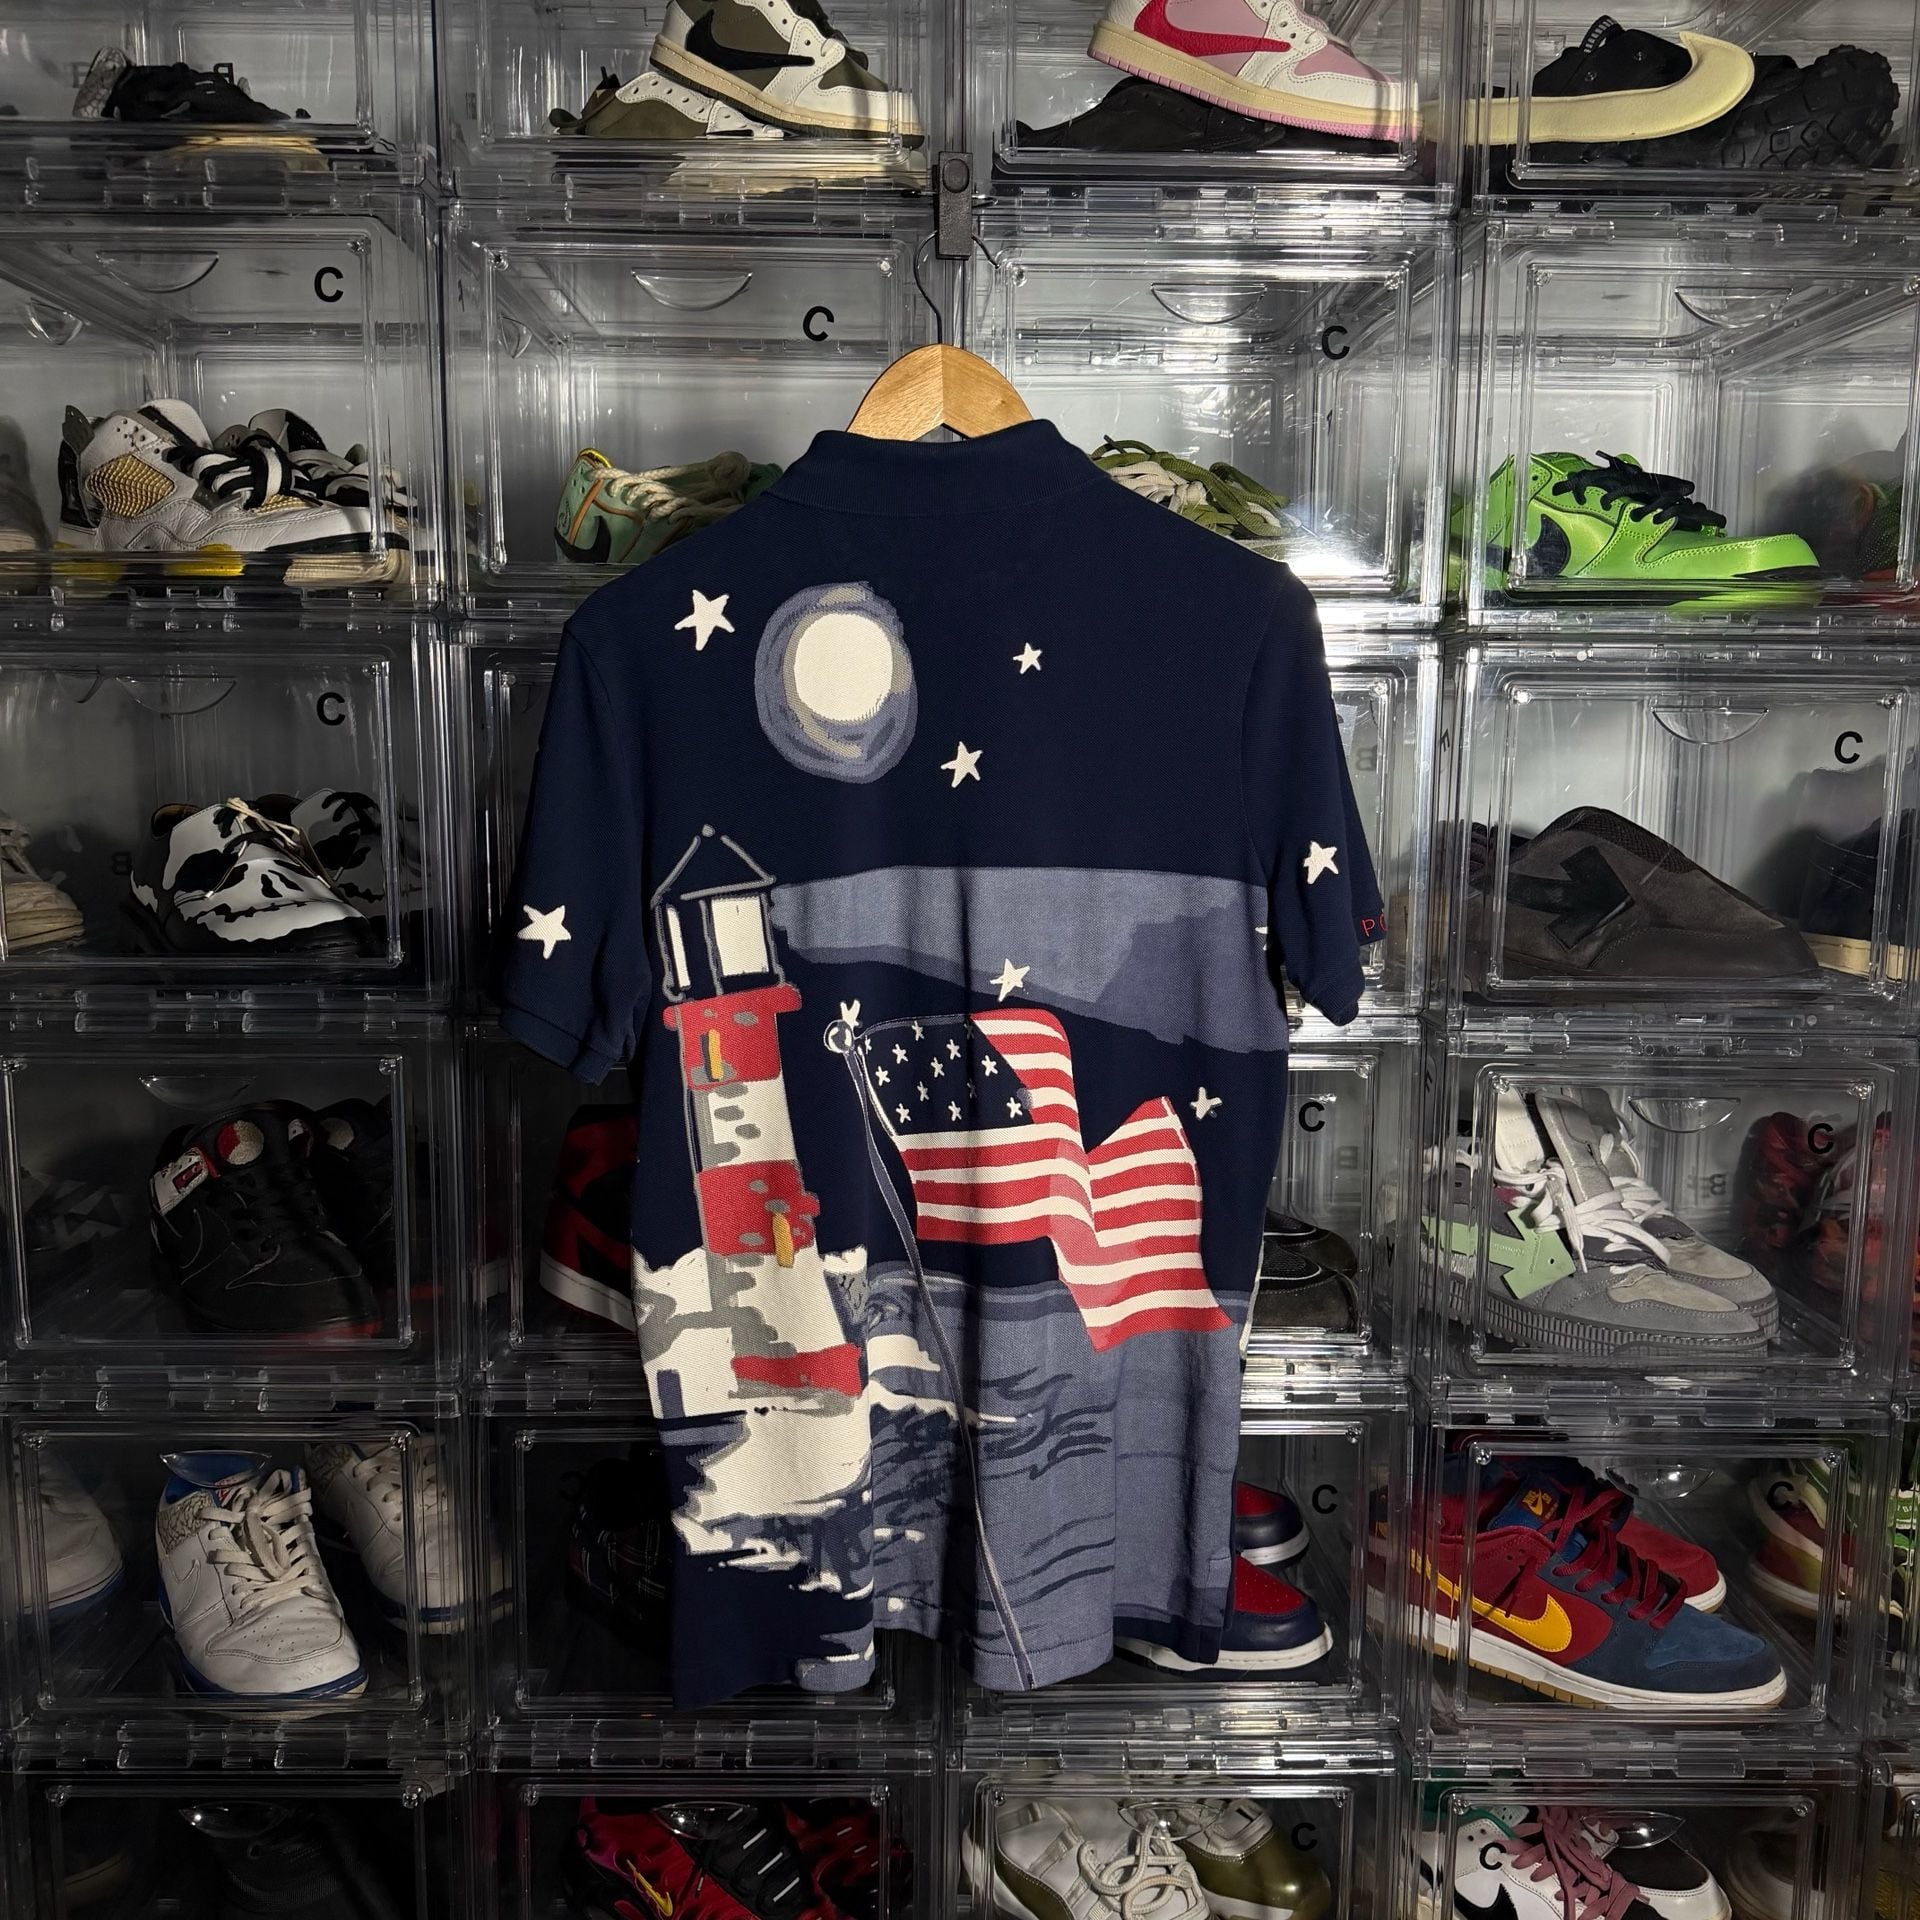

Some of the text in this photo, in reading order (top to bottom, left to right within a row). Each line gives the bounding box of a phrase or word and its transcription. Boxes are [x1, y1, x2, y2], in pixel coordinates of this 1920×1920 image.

[314, 266, 344, 303] C
[802, 305, 835, 342] C
[1321, 325, 1351, 361] C
[316, 691, 346, 727] C
[1834, 731, 1864, 765] C
[1298, 1100, 1326, 1133] C
[1807, 1122, 1835, 1155] C
[1311, 1484, 1339, 1515] C
[1767, 1480, 1795, 1512] C
[1291, 1821, 1319, 1852] C
[1478, 1841, 1508, 1871] C
